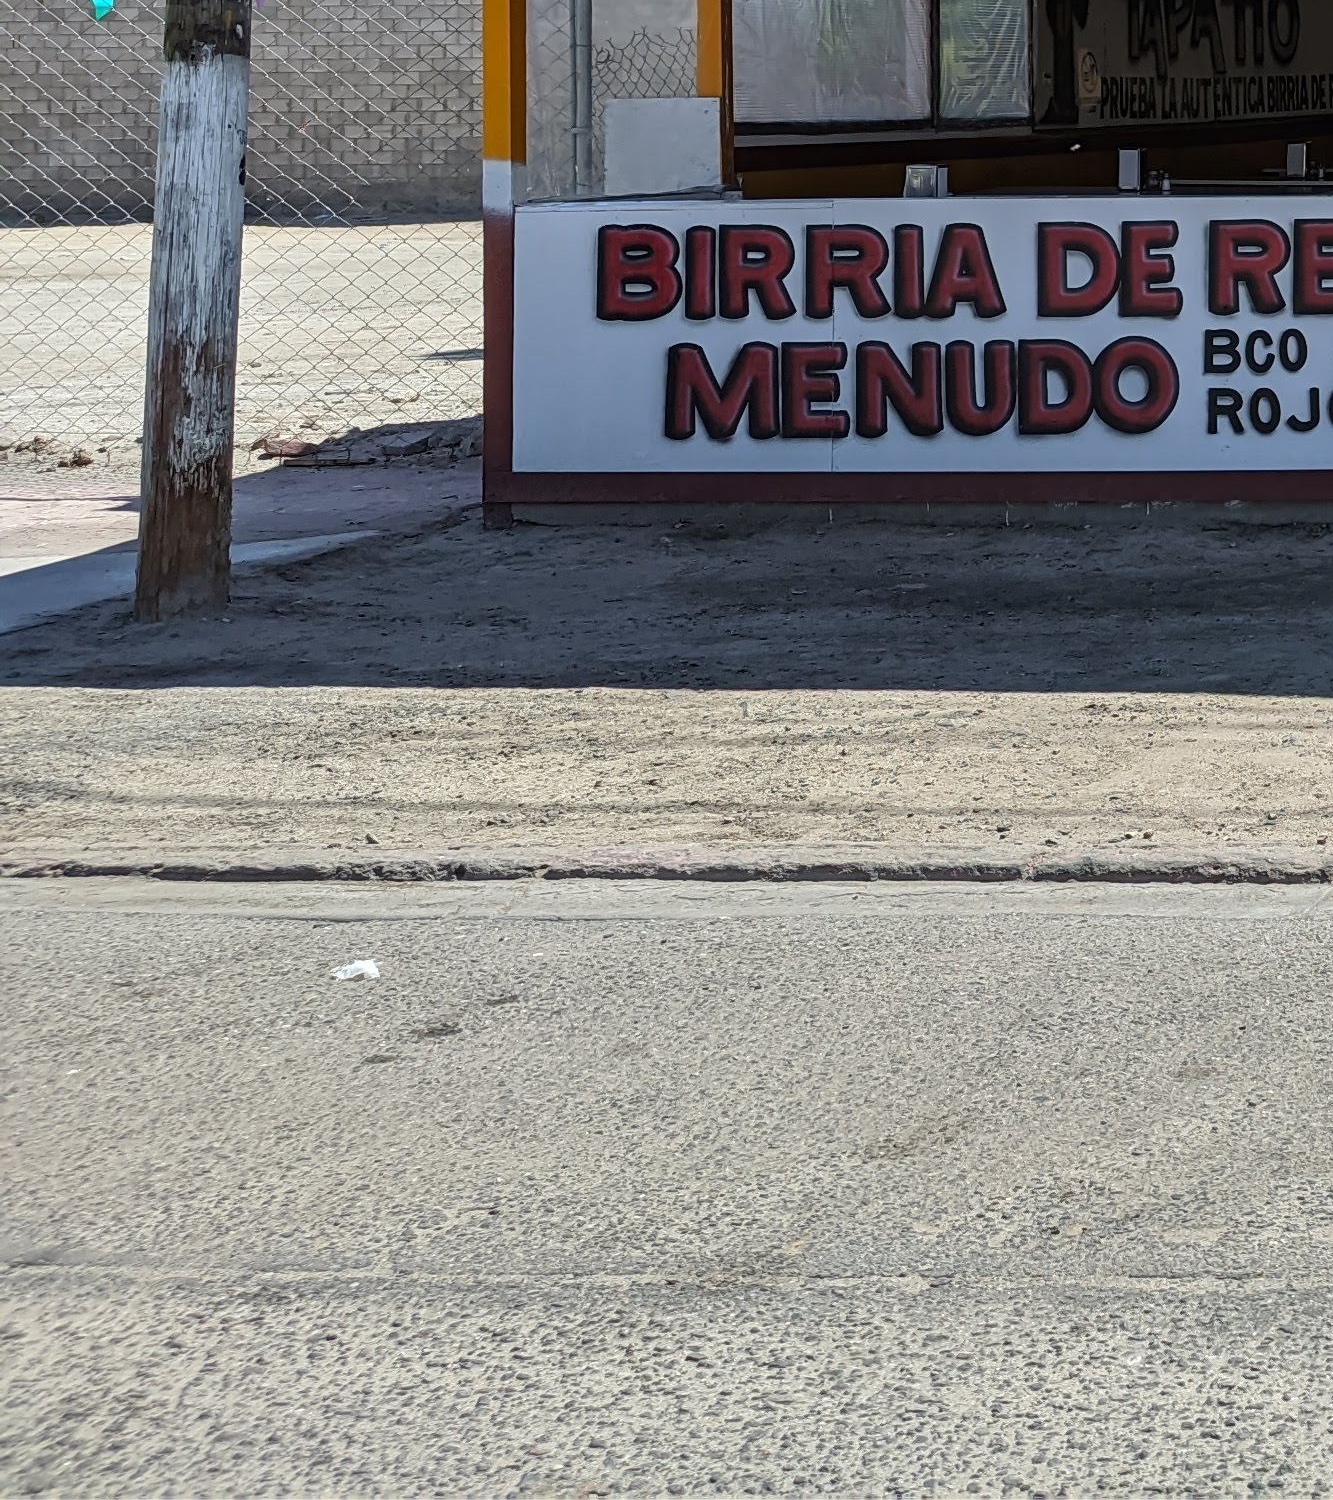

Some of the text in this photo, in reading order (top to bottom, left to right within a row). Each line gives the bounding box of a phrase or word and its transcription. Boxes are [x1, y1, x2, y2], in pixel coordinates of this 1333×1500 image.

[1100, 77, 1157, 119] PRUEBA
[1161, 77, 1178, 119] LA
[1181, 75, 1264, 118] AUTENTICA
[1266, 75, 1308, 112] BIRRIA
[1310, 74, 1326, 109] DE
[598, 222, 1007, 322] BIRRIA
[1036, 219, 1184, 320] DE
[664, 335, 1180, 441] MENUDO
[1202, 328, 1308, 375] BCO
